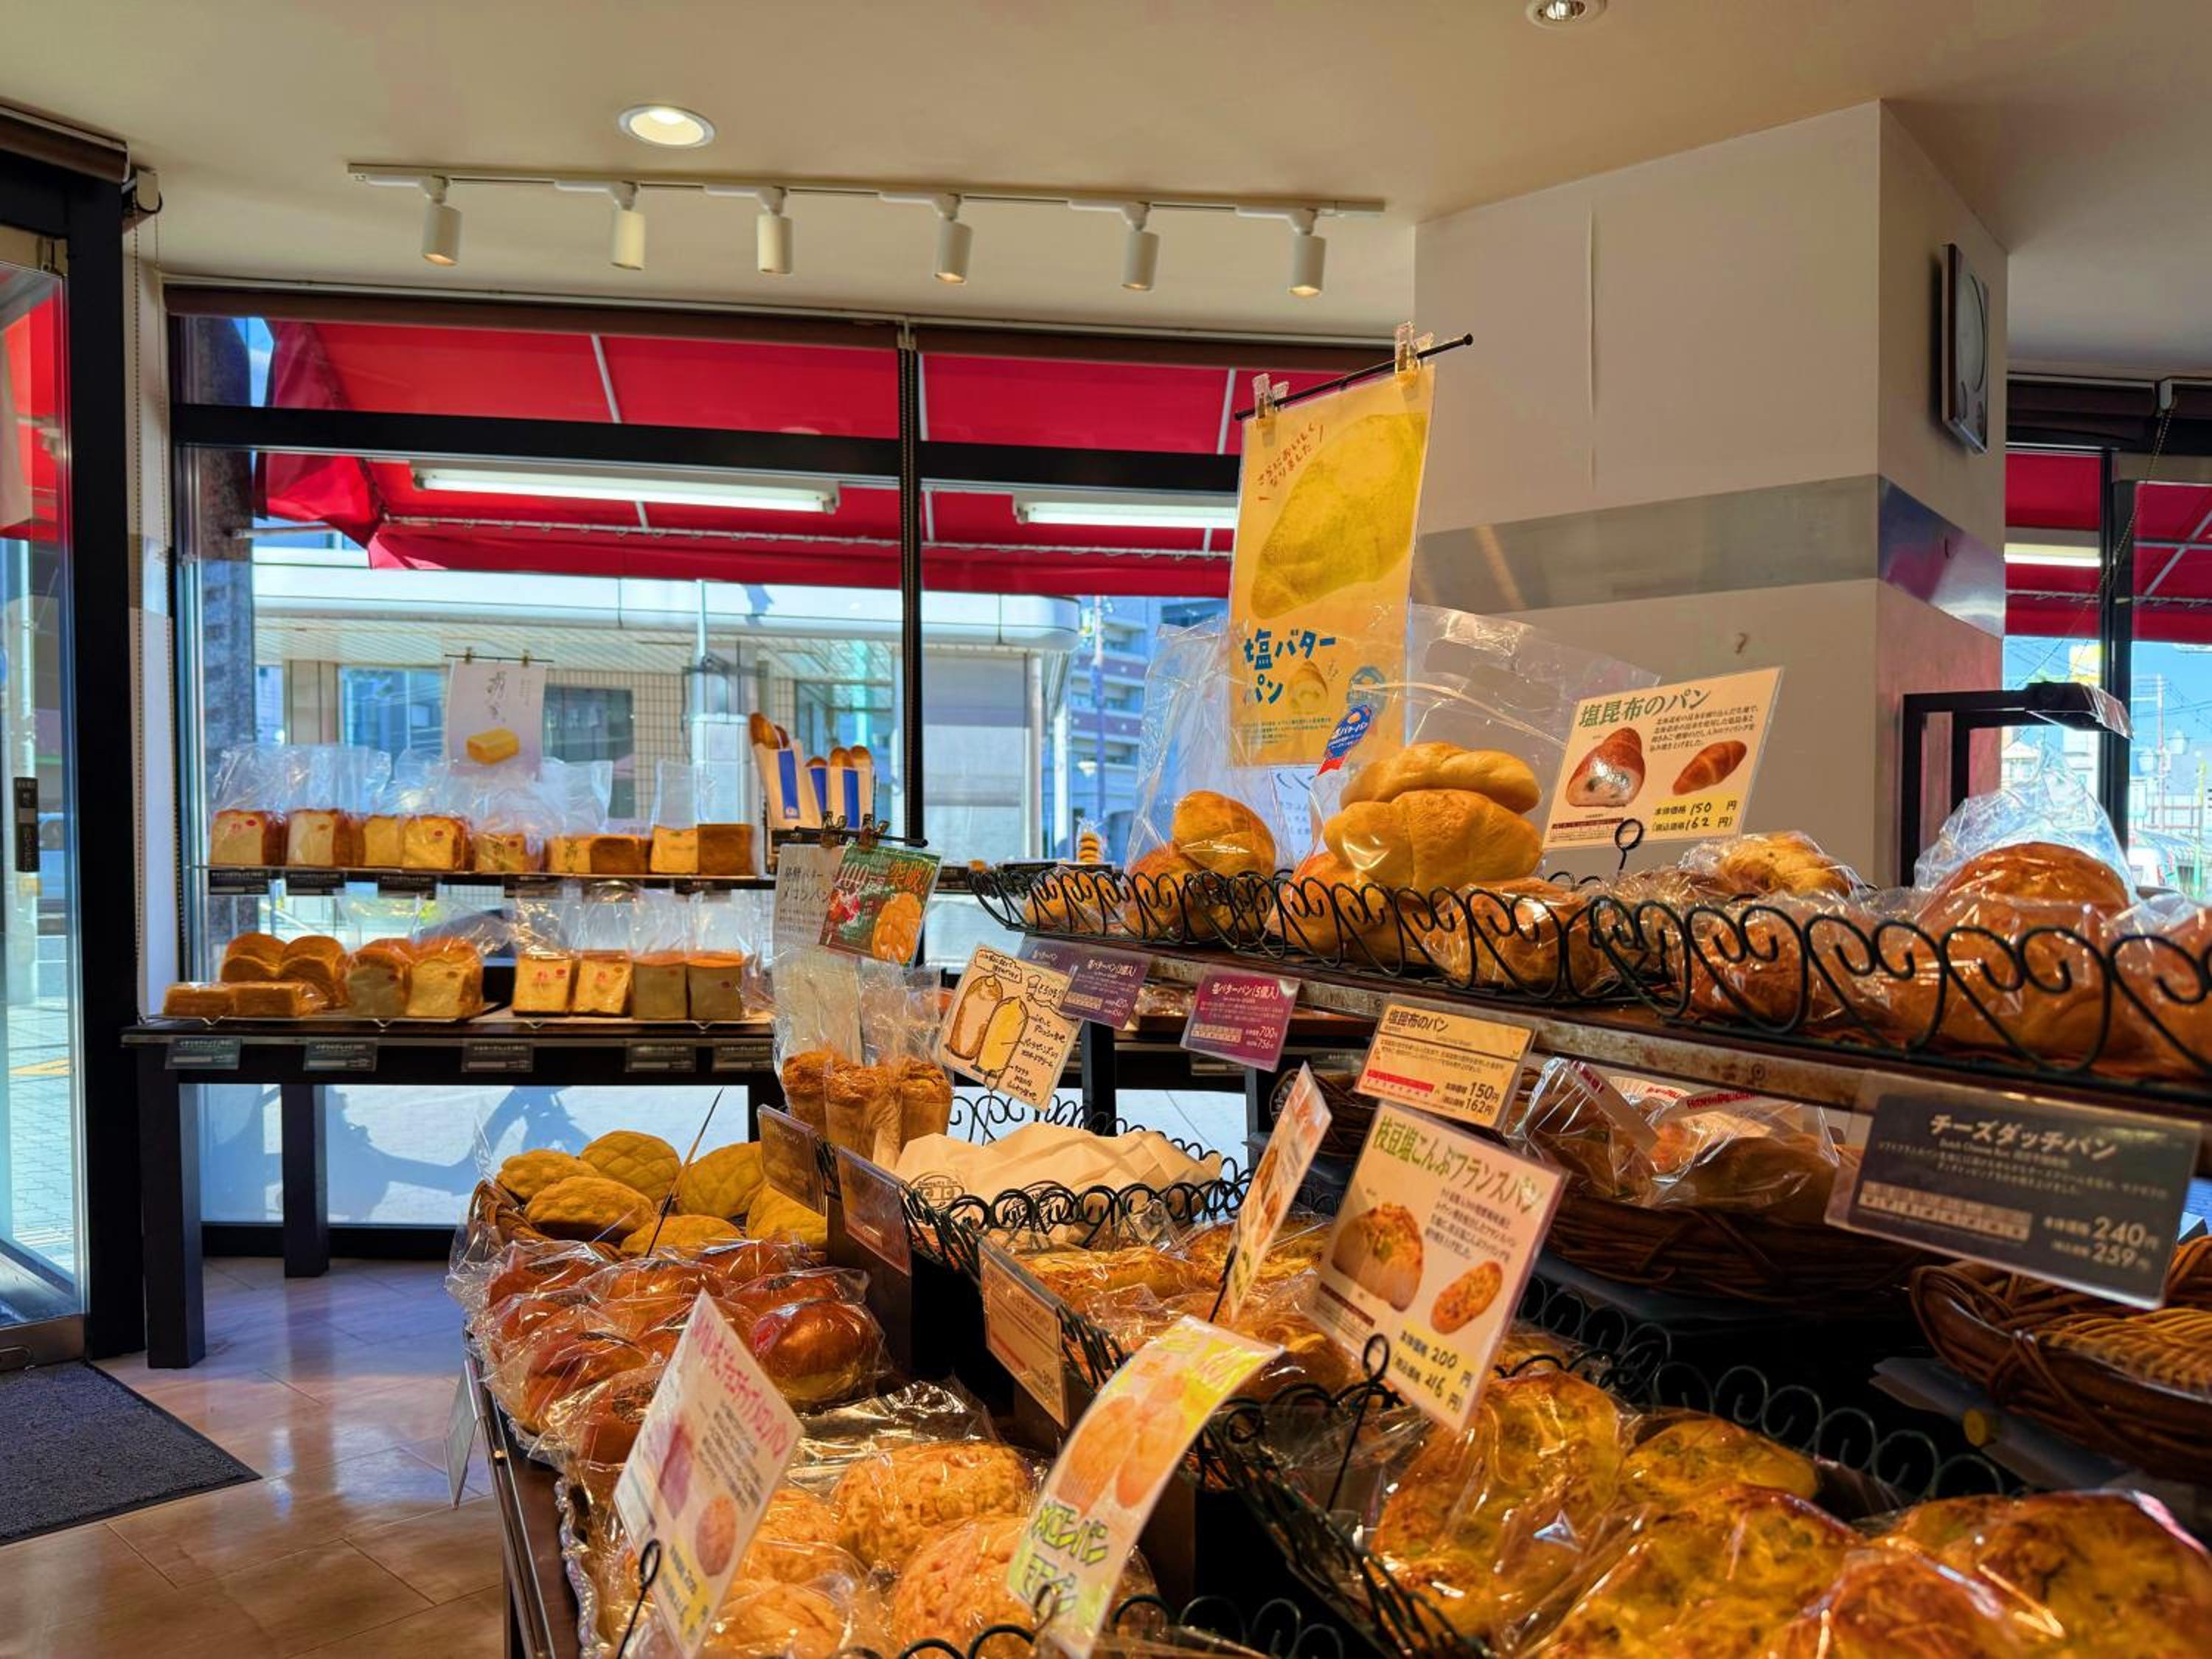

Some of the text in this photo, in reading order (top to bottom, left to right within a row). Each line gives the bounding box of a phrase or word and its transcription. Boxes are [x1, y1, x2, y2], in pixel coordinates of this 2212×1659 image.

[1245, 628, 1336, 670] 塩バター
[1255, 673, 1284, 704] パン
[1579, 689, 1711, 728] 塩昆布のパン
[1686, 817, 1709, 831] 162
[1689, 801, 1712, 815] 150
[1727, 800, 1738, 811] 円
[1387, 1009, 1449, 1032] 塩昆布のパン
[1469, 1081, 1500, 1103] 150円
[1929, 1113, 2118, 1162] チーズダッチパン
[1372, 1114, 1543, 1214] 枝豆塩こんぶフランスパン
[1431, 1346, 1458, 1369] 200
[1461, 1369, 1473, 1389] 円
